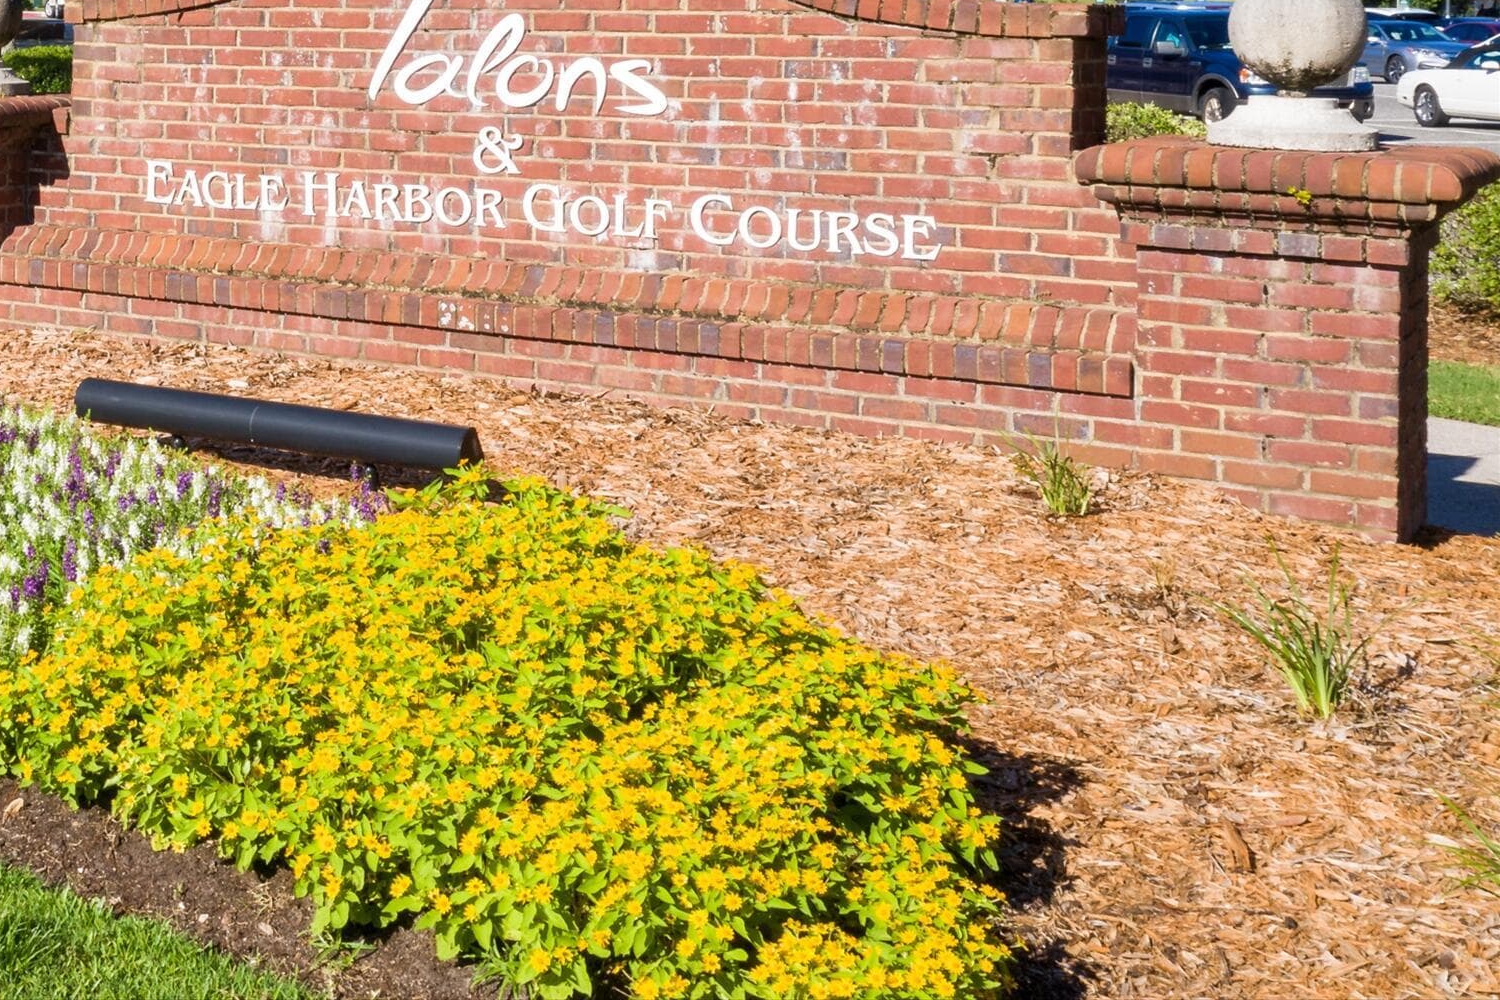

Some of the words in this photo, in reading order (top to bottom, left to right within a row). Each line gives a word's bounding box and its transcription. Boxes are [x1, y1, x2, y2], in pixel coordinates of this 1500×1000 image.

[472, 125, 523, 175] &
[144, 159, 289, 213] EAGLE
[301, 171, 507, 230] HARBOR
[522, 183, 673, 239] GOLF
[690, 194, 943, 262] COURSE
